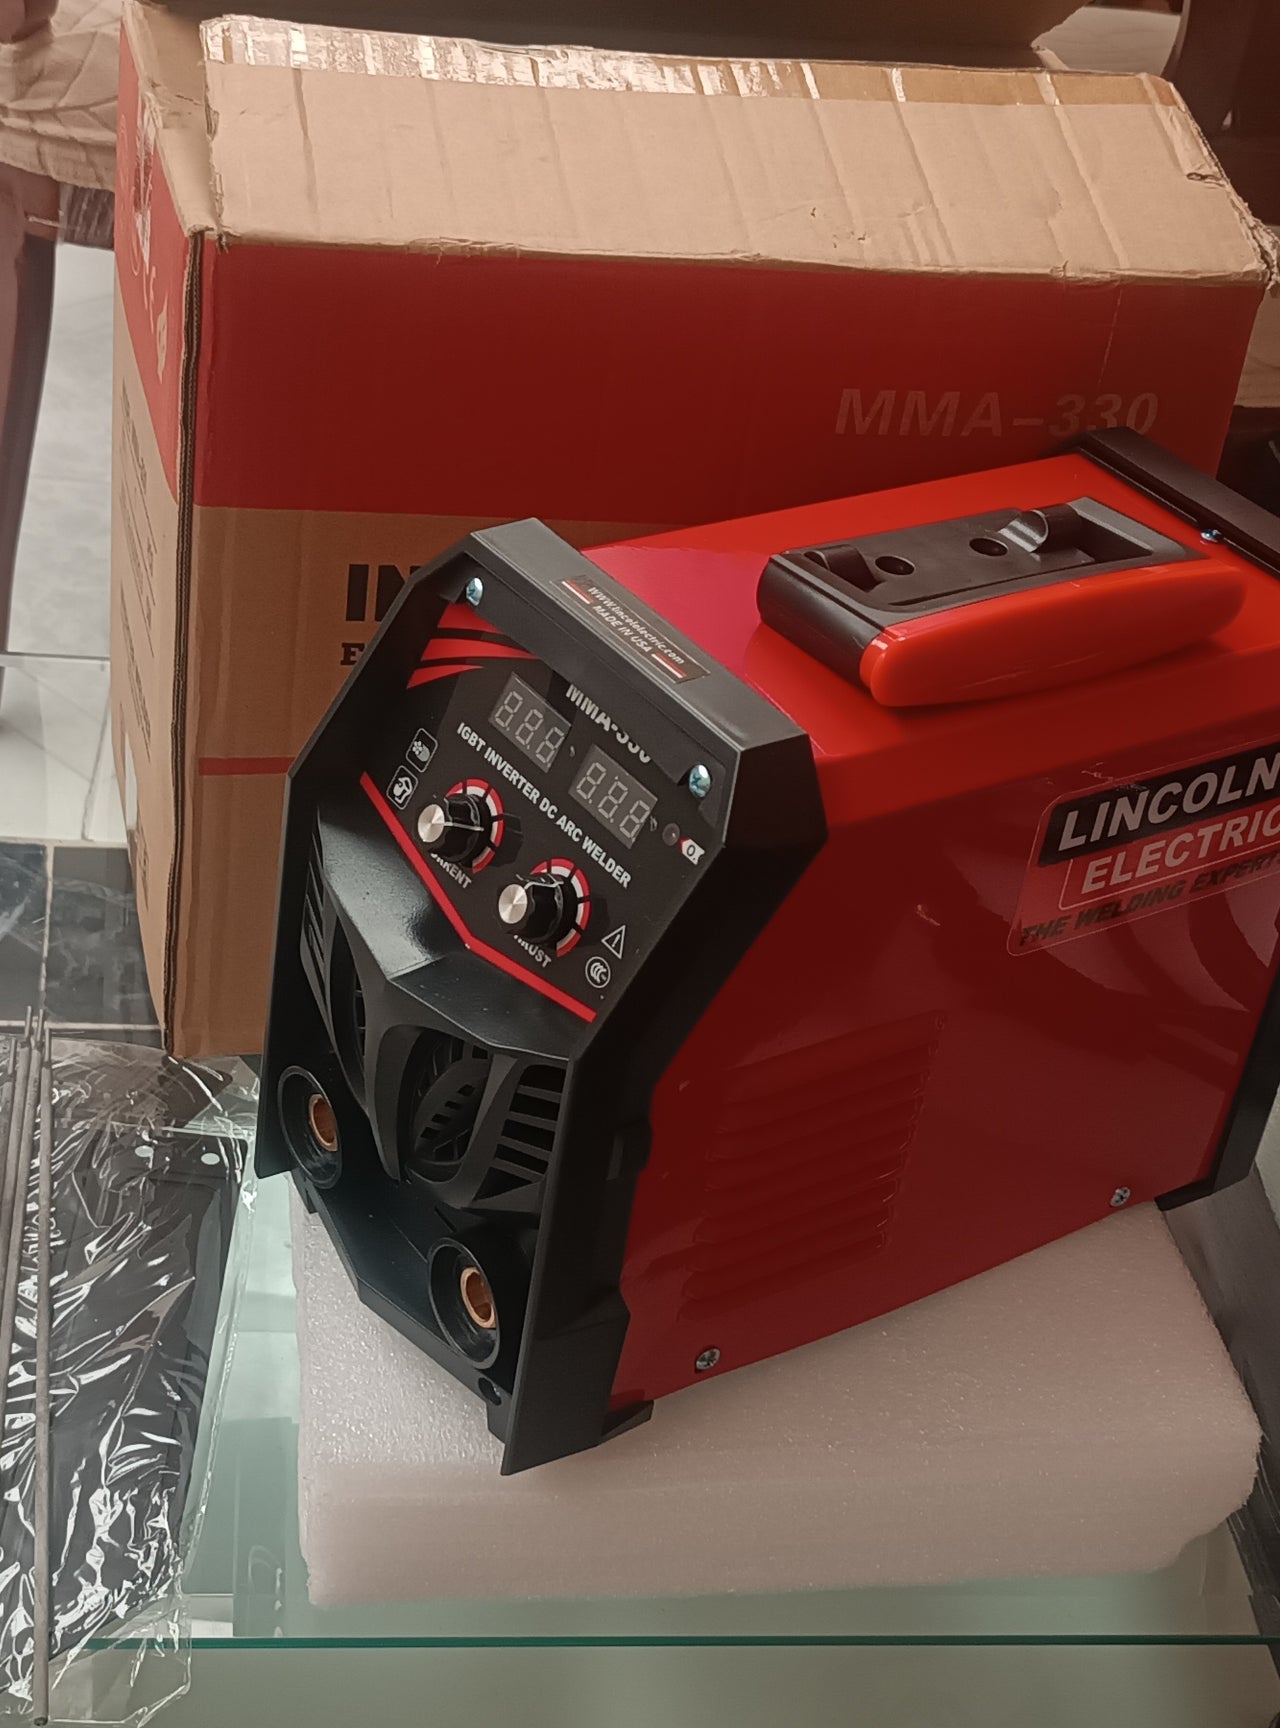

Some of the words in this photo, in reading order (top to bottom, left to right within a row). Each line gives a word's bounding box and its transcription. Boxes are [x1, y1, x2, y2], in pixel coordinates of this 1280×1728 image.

[833, 388, 1159, 437] MMA-330
[592, 605, 622, 628] MADE
[619, 626, 633, 638] IN
[630, 635, 654, 653] USA
[456, 722, 487, 752] IGBT
[483, 747, 542, 805] INVERTER
[538, 797, 558, 819] DC
[556, 814, 583, 842] ARC
[581, 833, 633, 889] WELDER
[1020, 914, 1074, 946] THE
[1073, 878, 1186, 931] WELDING
